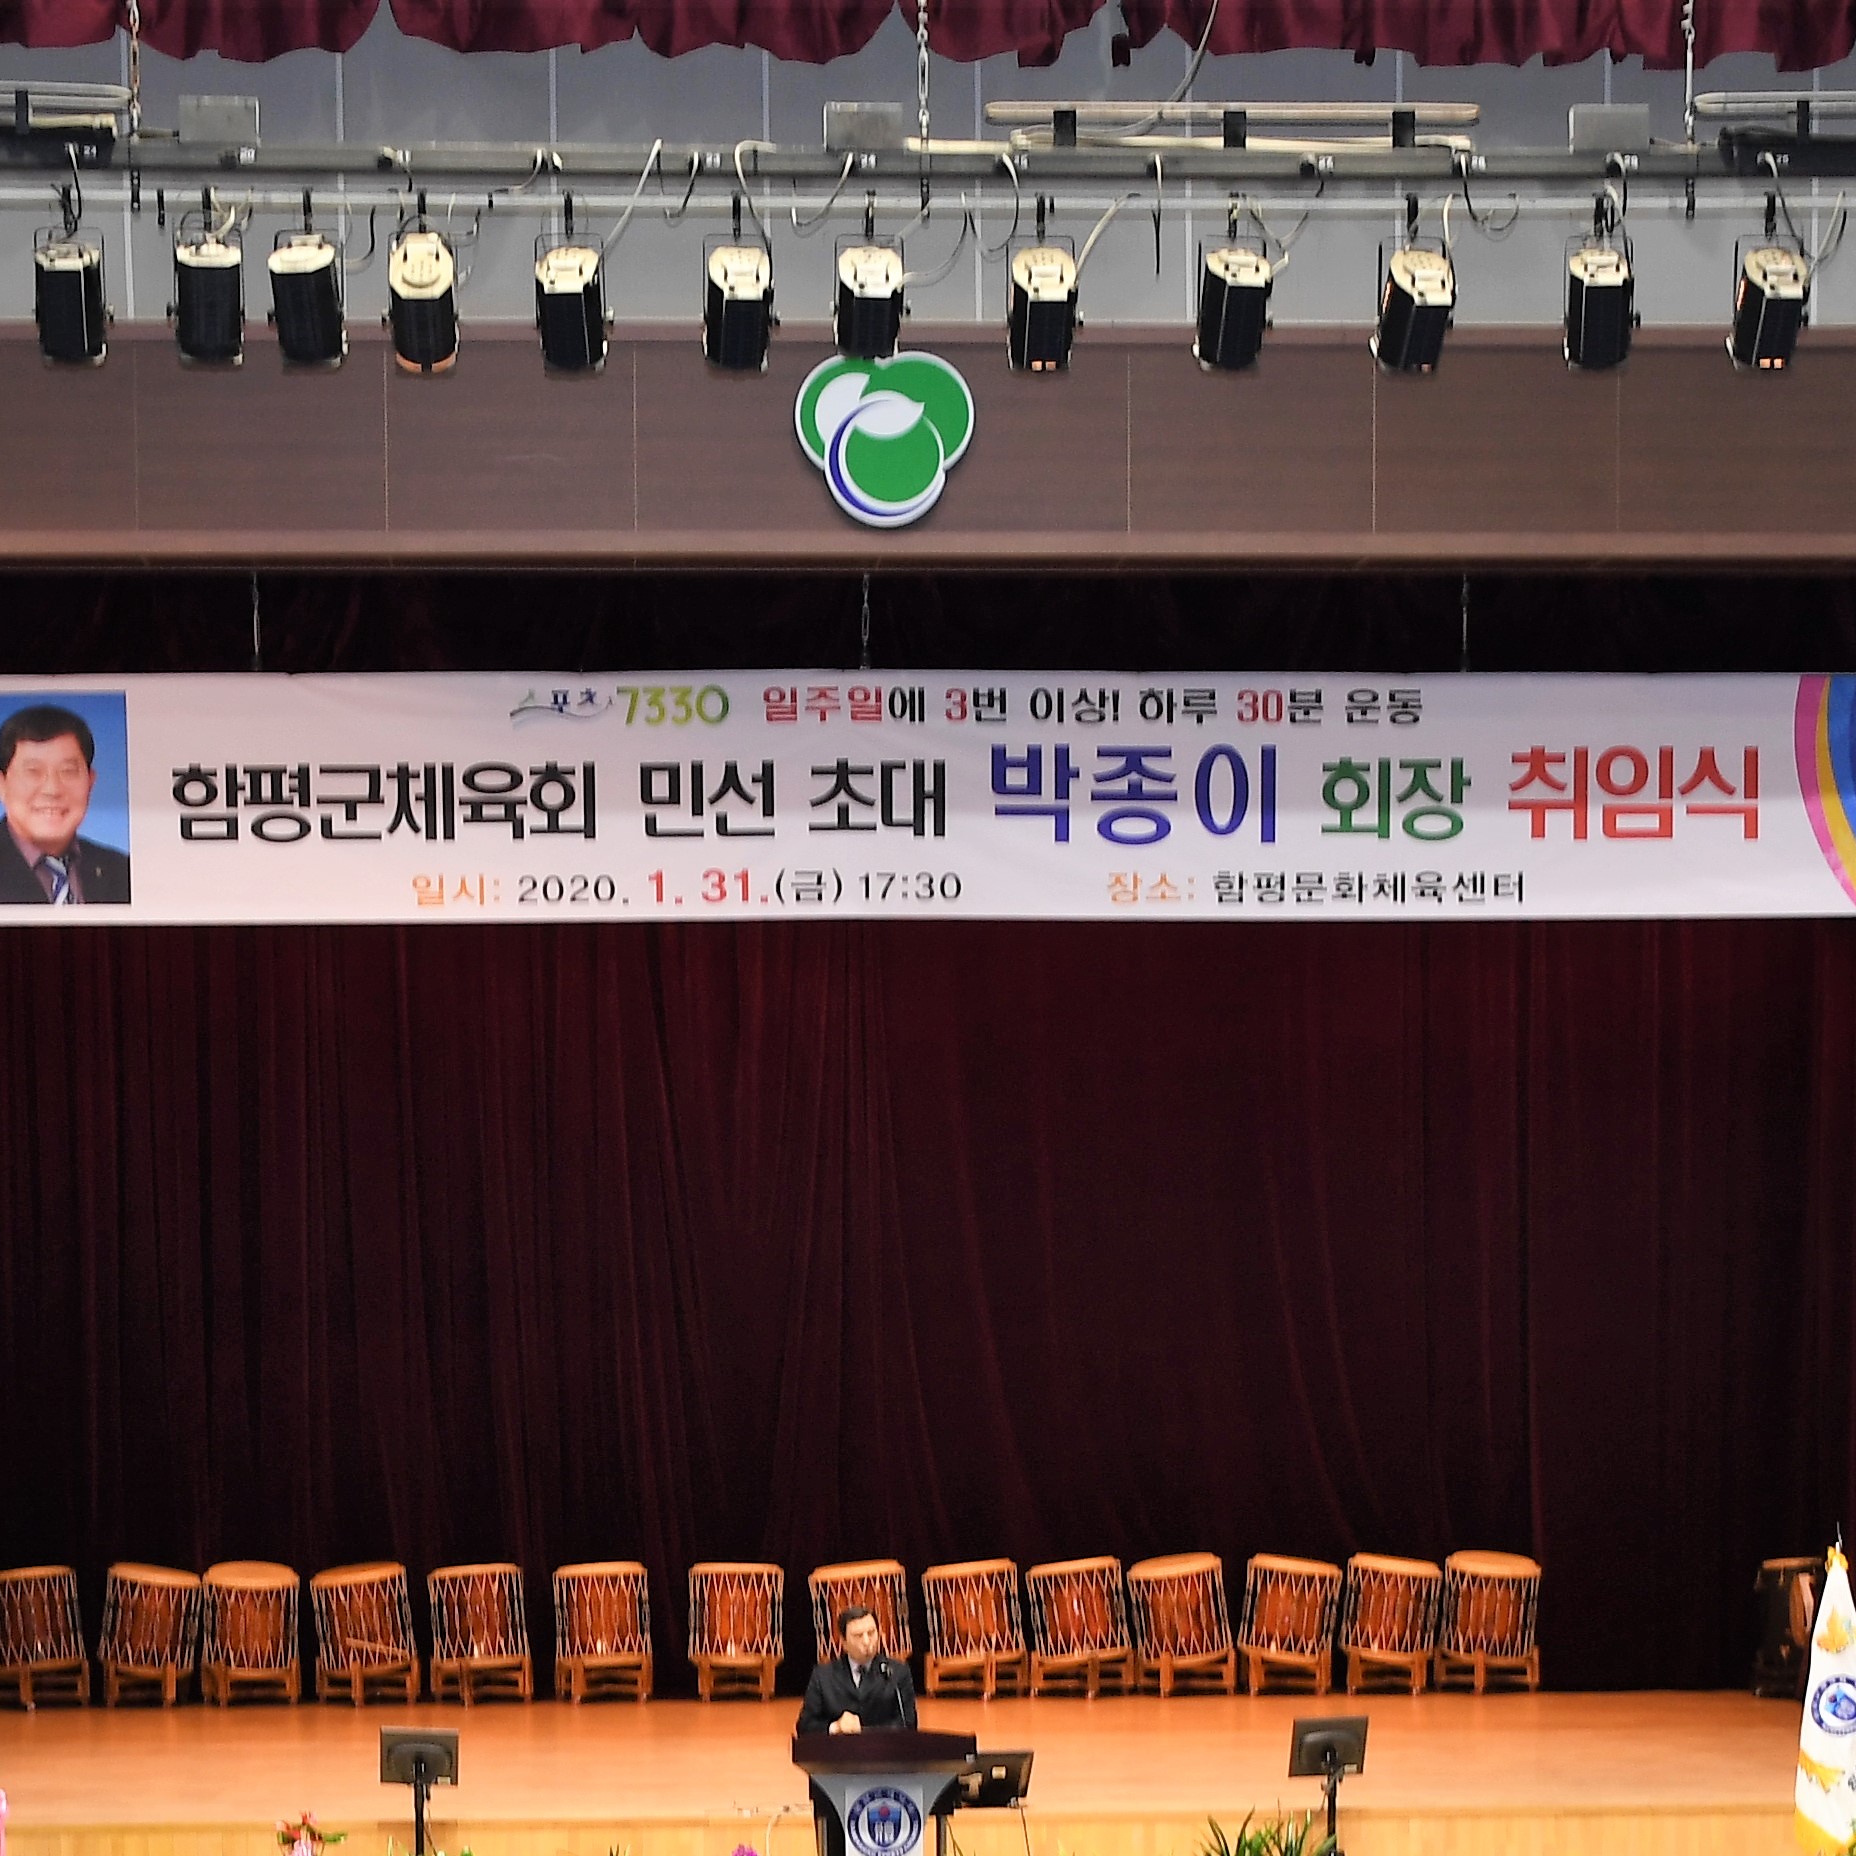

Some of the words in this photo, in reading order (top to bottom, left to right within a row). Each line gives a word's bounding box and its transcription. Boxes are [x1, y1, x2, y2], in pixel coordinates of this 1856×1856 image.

[617, 685, 729, 725] 7330
[763, 686, 926, 723] 일주일에
[945, 687, 1008, 723] 3번
[1029, 687, 1120, 724] 이상!
[1139, 687, 1218, 724] 하루
[1236, 688, 1324, 724] 30분
[1345, 689, 1423, 724] 운동
[171, 760, 597, 843] 함평군체육회
[640, 758, 776, 840] 민선
[809, 757, 946, 840] 초대
[990, 743, 1277, 845] 박종이
[1321, 756, 1472, 841] 회장
[1508, 746, 1761, 840] 취임식
[411, 873, 502, 907] 일시:
[517, 874, 631, 905] 2020.
[648, 869, 689, 905] 1.
[858, 872, 963, 902] 17:30
[1107, 872, 1197, 905] 장소:
[1212, 871, 1527, 905] 함평문화체육센터
